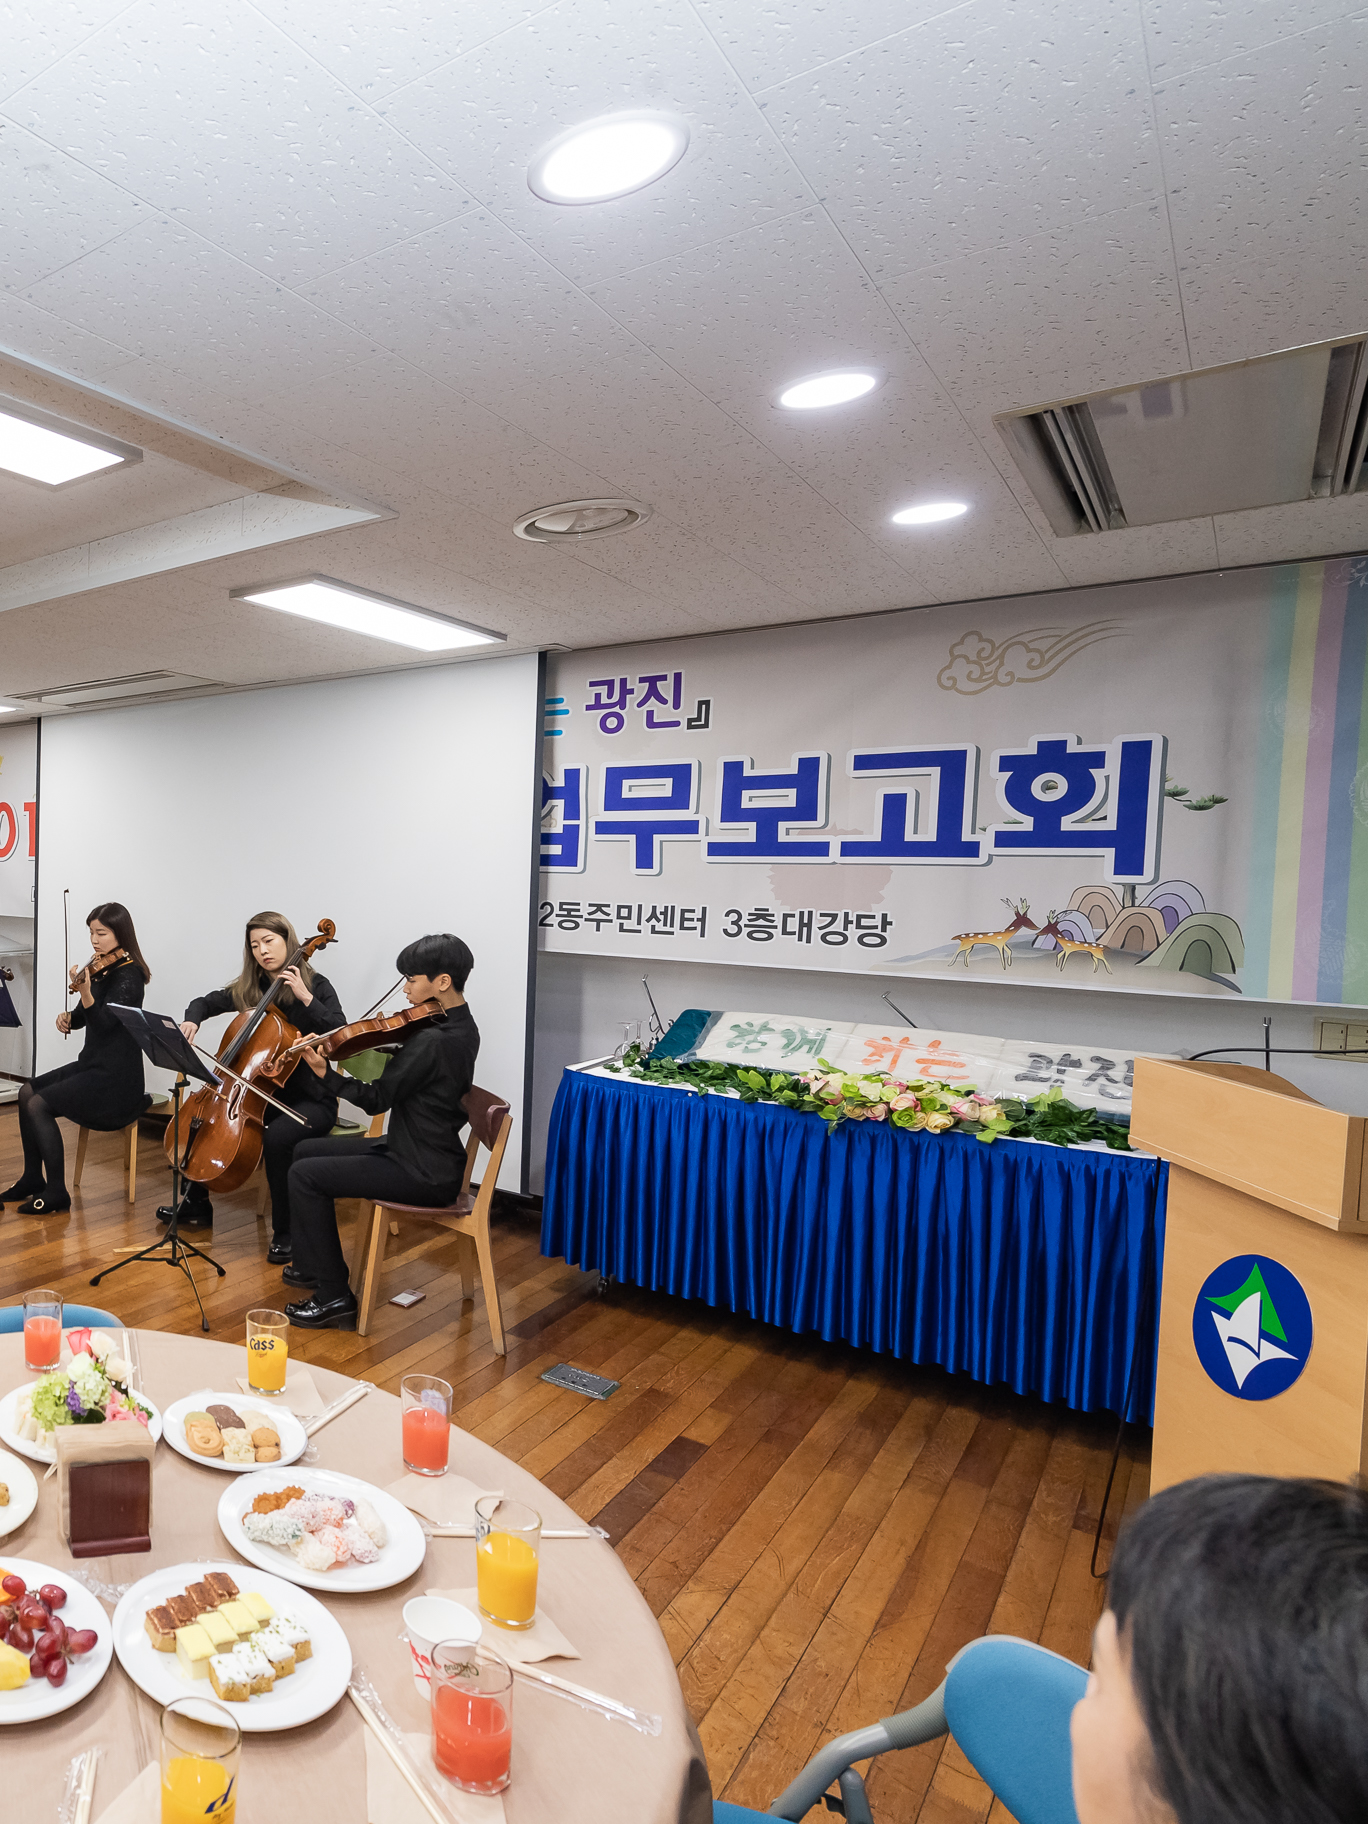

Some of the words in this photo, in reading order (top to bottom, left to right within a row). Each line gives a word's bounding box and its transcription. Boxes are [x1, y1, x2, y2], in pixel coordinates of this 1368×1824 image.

[538, 901, 707, 938] 2동주민센터
[722, 907, 893, 948] 3층대강당
[861, 1036, 970, 1080] 하는
[249, 1338, 275, 1350] Cass
